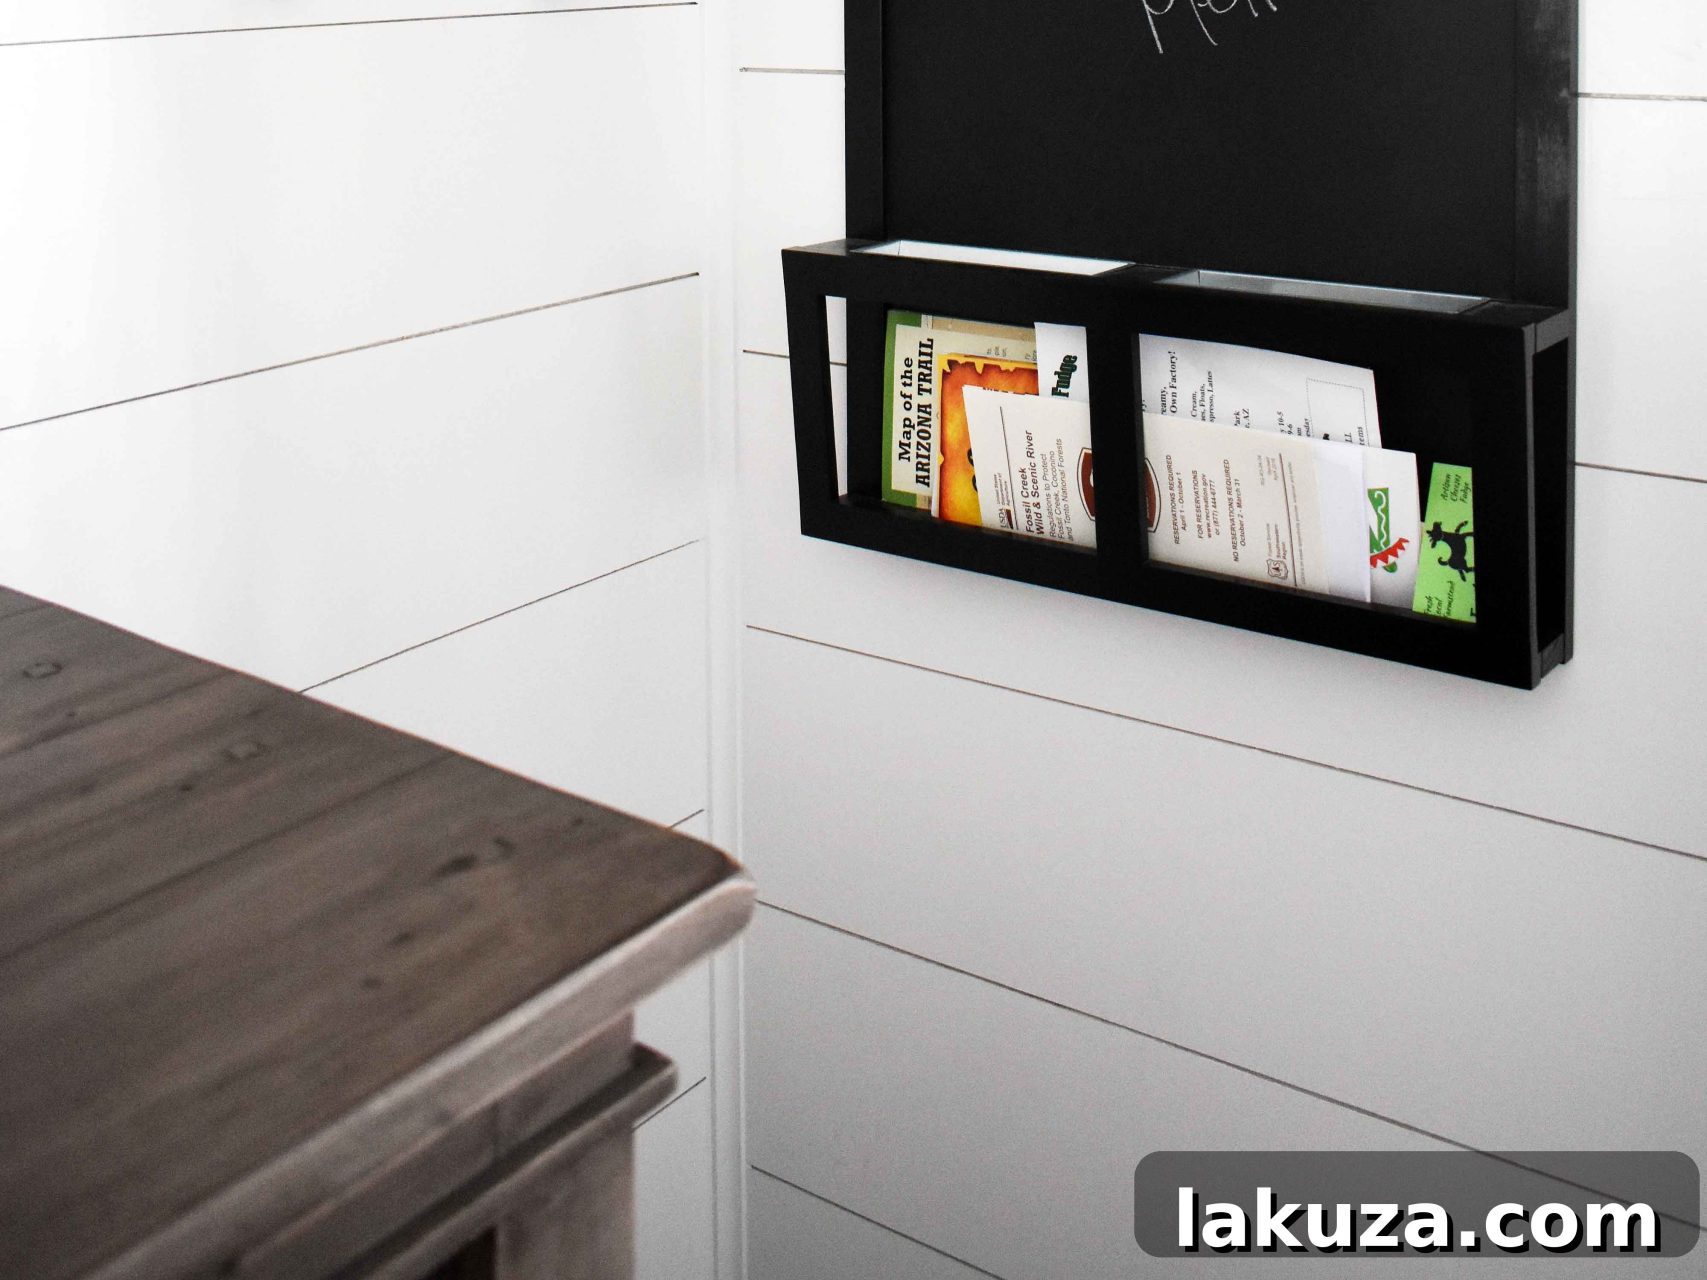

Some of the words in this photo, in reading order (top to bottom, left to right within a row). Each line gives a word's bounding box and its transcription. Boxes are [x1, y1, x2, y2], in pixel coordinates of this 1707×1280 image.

[901, 358, 913, 387] the
[918, 338, 933, 396] TRAIL
[1052, 355, 1077, 397] Fudge
[1168, 351, 1177, 389] Factory!
[900, 390, 912, 411] of
[898, 418, 914, 462] Map
[916, 403, 932, 488] ARIZONA
[1024, 430, 1035, 459] River
[1055, 438, 1065, 467] Forests
[1019, 467, 1029, 498] Creek
[1029, 462, 1039, 498] Scenic
[1040, 453, 1049, 481] Protect
[1166, 455, 1174, 491] REQUIRED
[1224, 459, 1232, 495] REQUIRED
[1060, 470, 1068, 502] National
[1192, 470, 1202, 522] RESERVATIONS
[1023, 501, 1034, 533] Fossil
[1034, 512, 1044, 535] Wild
[1046, 493, 1056, 537] Regulations
[1170, 493, 1180, 544] RESERVATIONS
[1202, 474, 1212, 538] www.recreation.gov
[1228, 497, 1238, 550] RESERVATIONS
[1055, 517, 1064, 539] Fossil
[1238, 520, 1246, 546] October
[1232, 551, 1239, 562] NO
